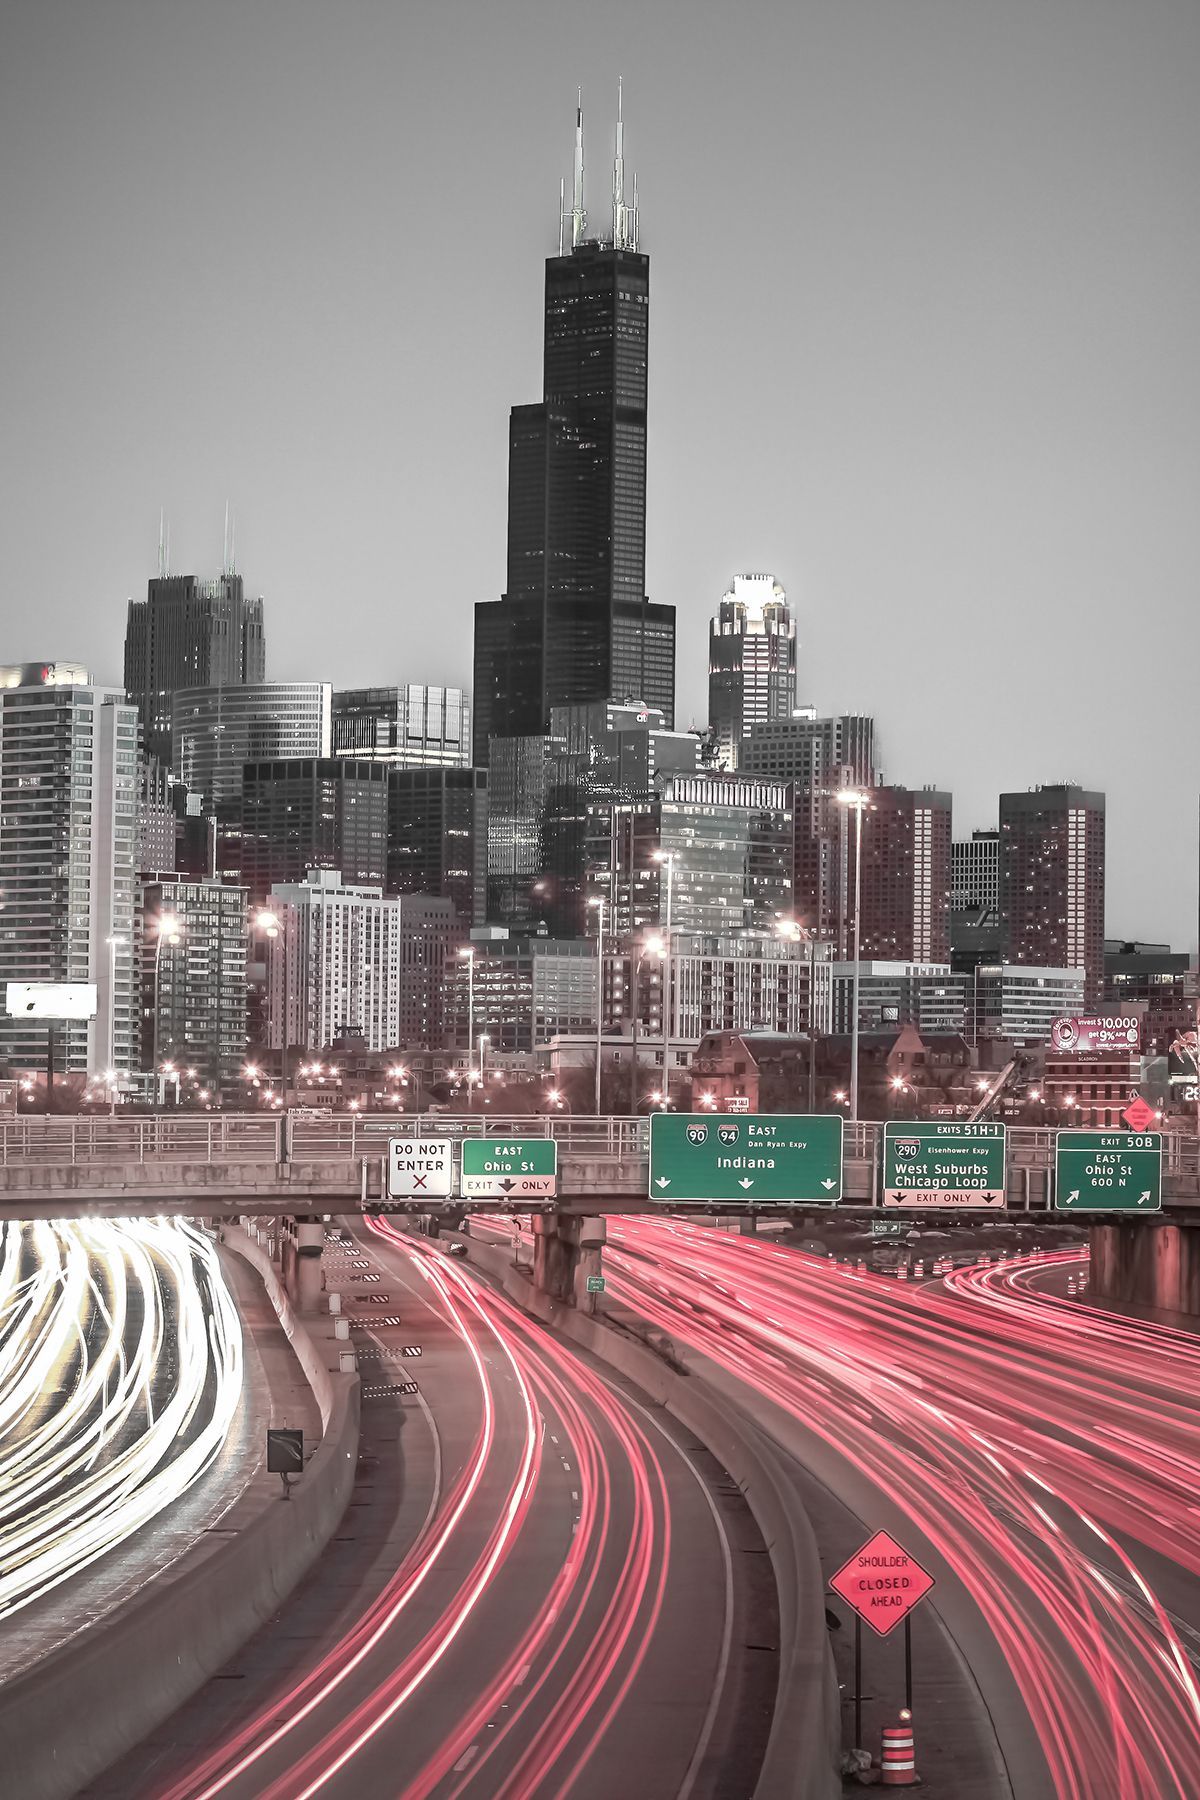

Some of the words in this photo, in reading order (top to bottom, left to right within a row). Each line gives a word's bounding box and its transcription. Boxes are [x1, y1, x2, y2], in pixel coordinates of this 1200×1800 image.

[1097, 1018, 1138, 1029] $10,000
[1100, 1031, 1114, 1041] 9%
[749, 1125, 776, 1135] EAST
[690, 1130, 704, 1142] 90
[720, 1130, 736, 1142] 94
[1128, 1137, 1152, 1147] 50B
[396, 1145, 412, 1154] DO
[420, 1145, 445, 1154] NOT
[495, 1147, 522, 1155] EAST
[898, 1145, 916, 1156] 290
[718, 1157, 774, 1168] Indiana
[1097, 1155, 1121, 1163] EAST
[398, 1161, 443, 1170] ENTER
[485, 1161, 511, 1171] Ohio
[521, 1162, 535, 1171] St
[895, 1164, 927, 1174] West
[935, 1164, 988, 1174] Suburbs
[1086, 1165, 1113, 1175] Ohio
[1121, 1166, 1131, 1175] St
[895, 1176, 948, 1189] Chicago
[956, 1177, 987, 1189] Loop
[1092, 1178, 1112, 1186] 600
[944, 1194, 970, 1202] ONLY
[858, 1556, 909, 1568] SHOULDER
[859, 1578, 910, 1590] CLOSED
[870, 1596, 903, 1607] AHEAD
